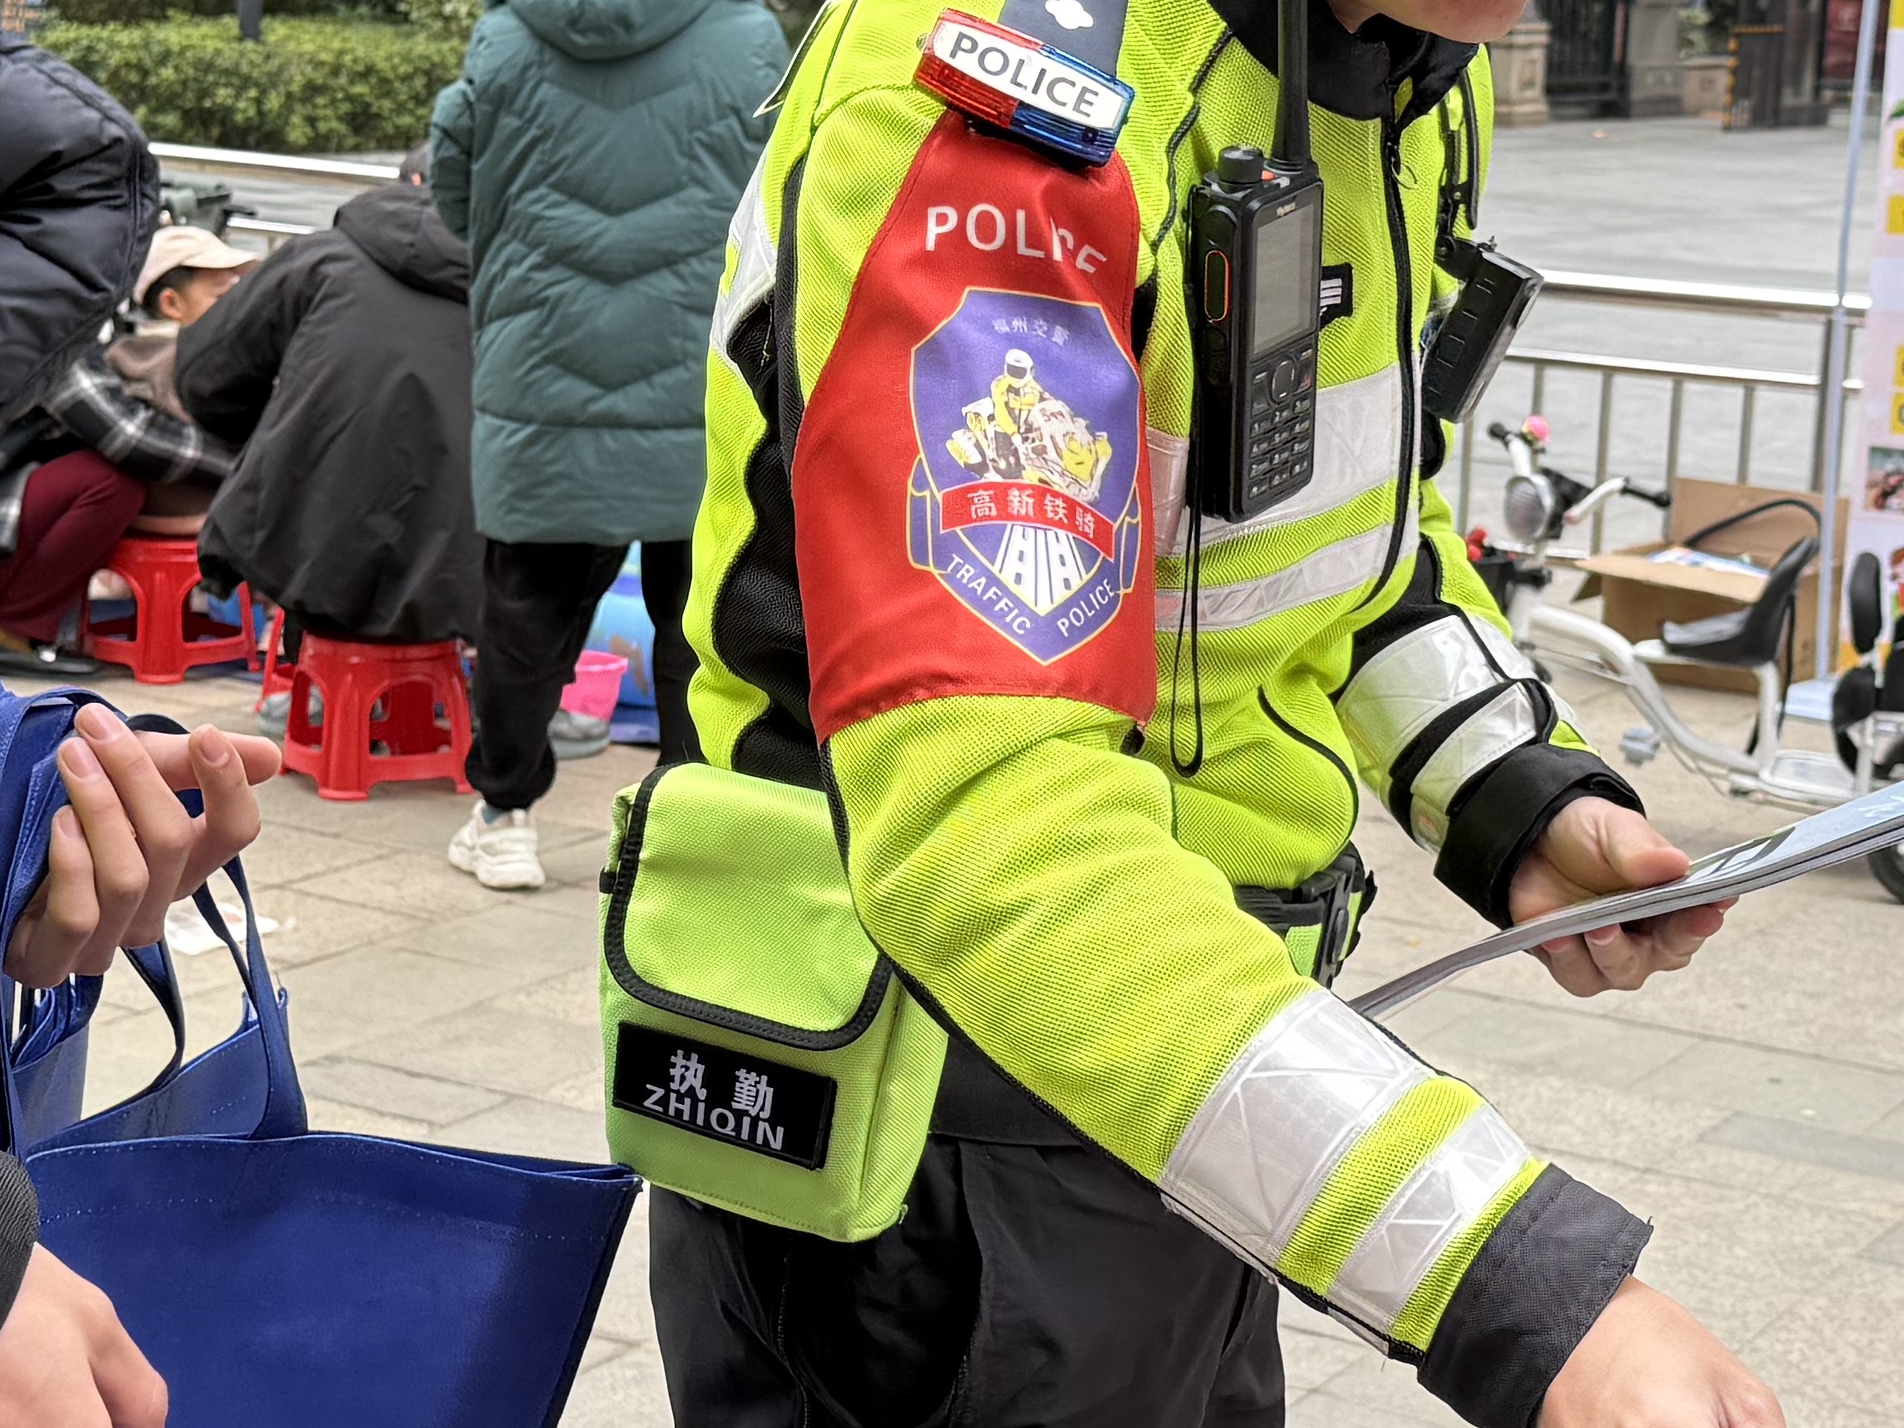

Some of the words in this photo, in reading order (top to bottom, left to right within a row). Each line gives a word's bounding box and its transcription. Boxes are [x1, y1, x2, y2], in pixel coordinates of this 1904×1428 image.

[949, 30, 1101, 118] POLICE
[967, 485, 1096, 542] 高新铁骑
[947, 553, 1033, 636] TRAFFIC
[1056, 576, 1116, 638] POLICE
[643, 1083, 785, 1151] ZHIQIN
[669, 1049, 773, 1120] 执勤
